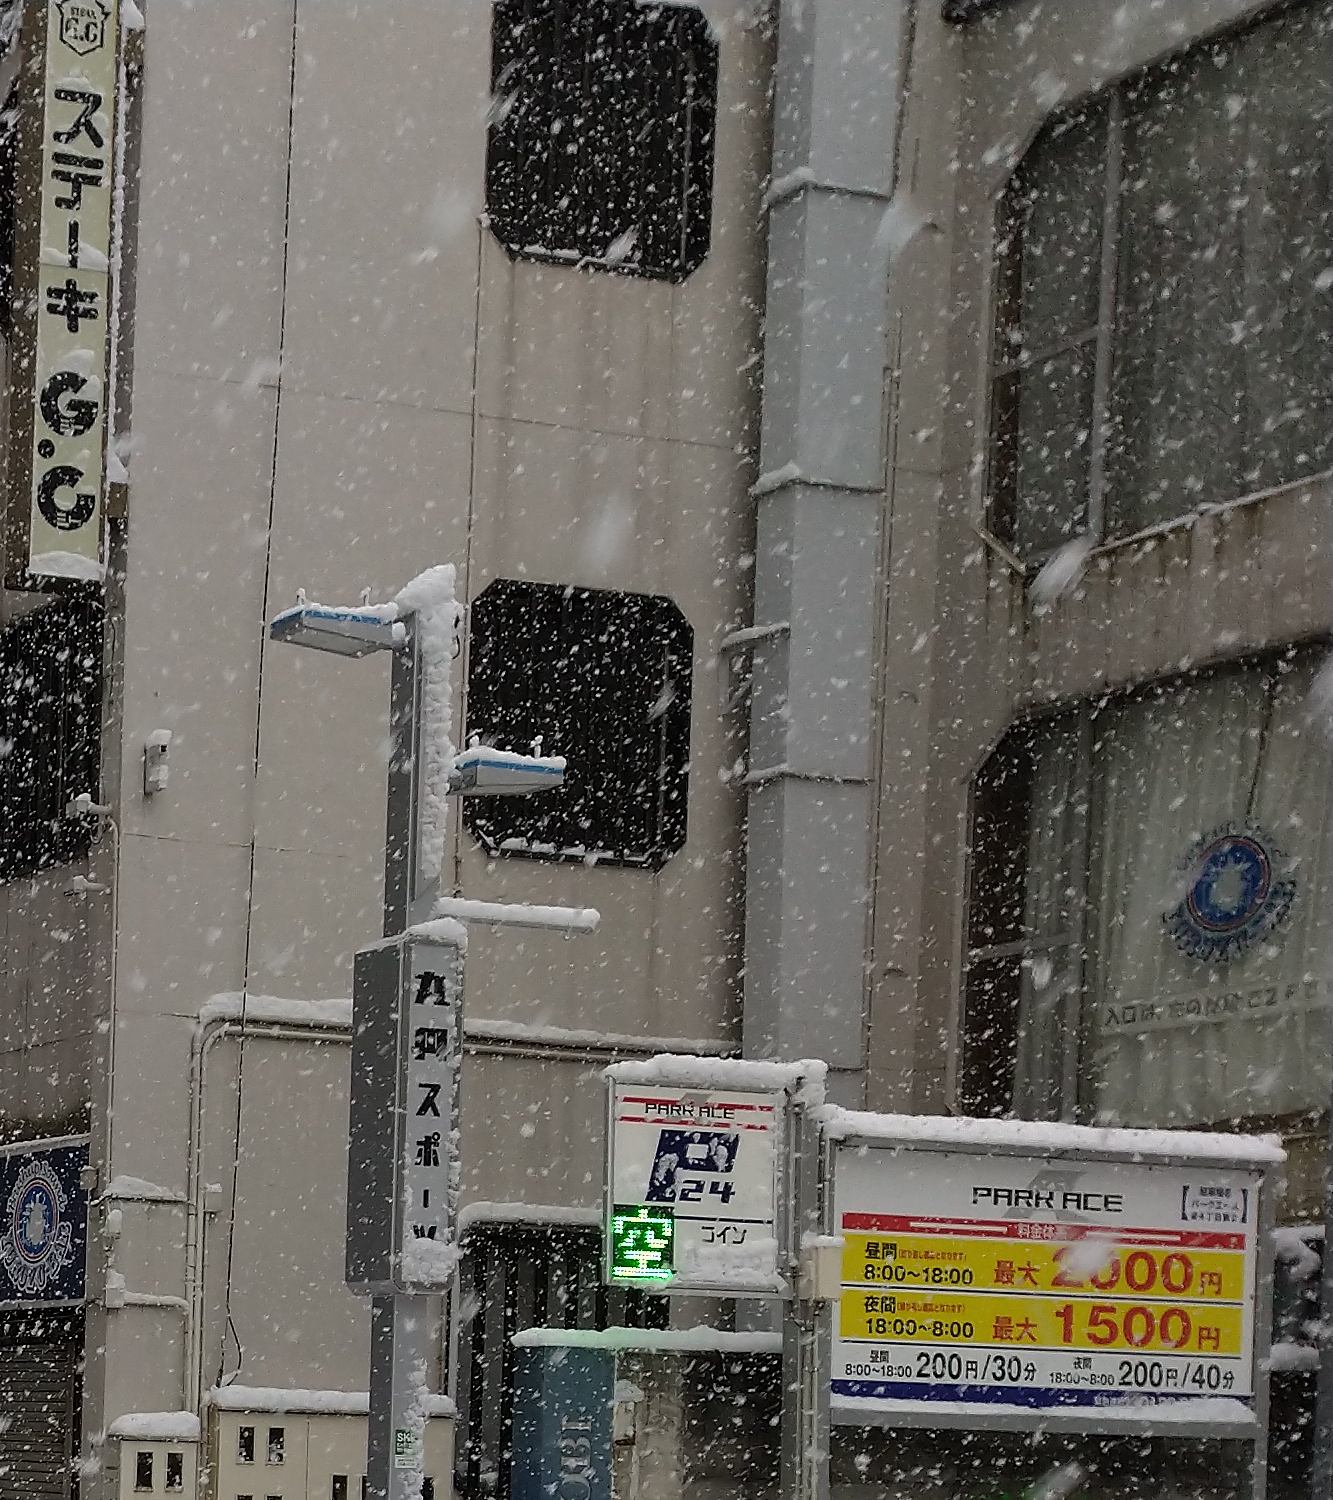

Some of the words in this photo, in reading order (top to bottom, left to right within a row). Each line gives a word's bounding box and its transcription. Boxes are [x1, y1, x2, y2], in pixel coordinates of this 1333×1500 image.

[46, 88, 105, 334] ステーキ
[645, 1102, 695, 1118] PARK
[698, 1105, 736, 1120] ACE
[678, 1179, 736, 1204] 24
[972, 1186, 1054, 1209] PARK
[1062, 1188, 1124, 1213] ACE
[701, 1225, 748, 1246] コイン
[864, 1241, 897, 1261] 昼間
[993, 1260, 1041, 1287] 最大
[864, 1295, 896, 1314] 夜間
[992, 1316, 1038, 1342] 最大
